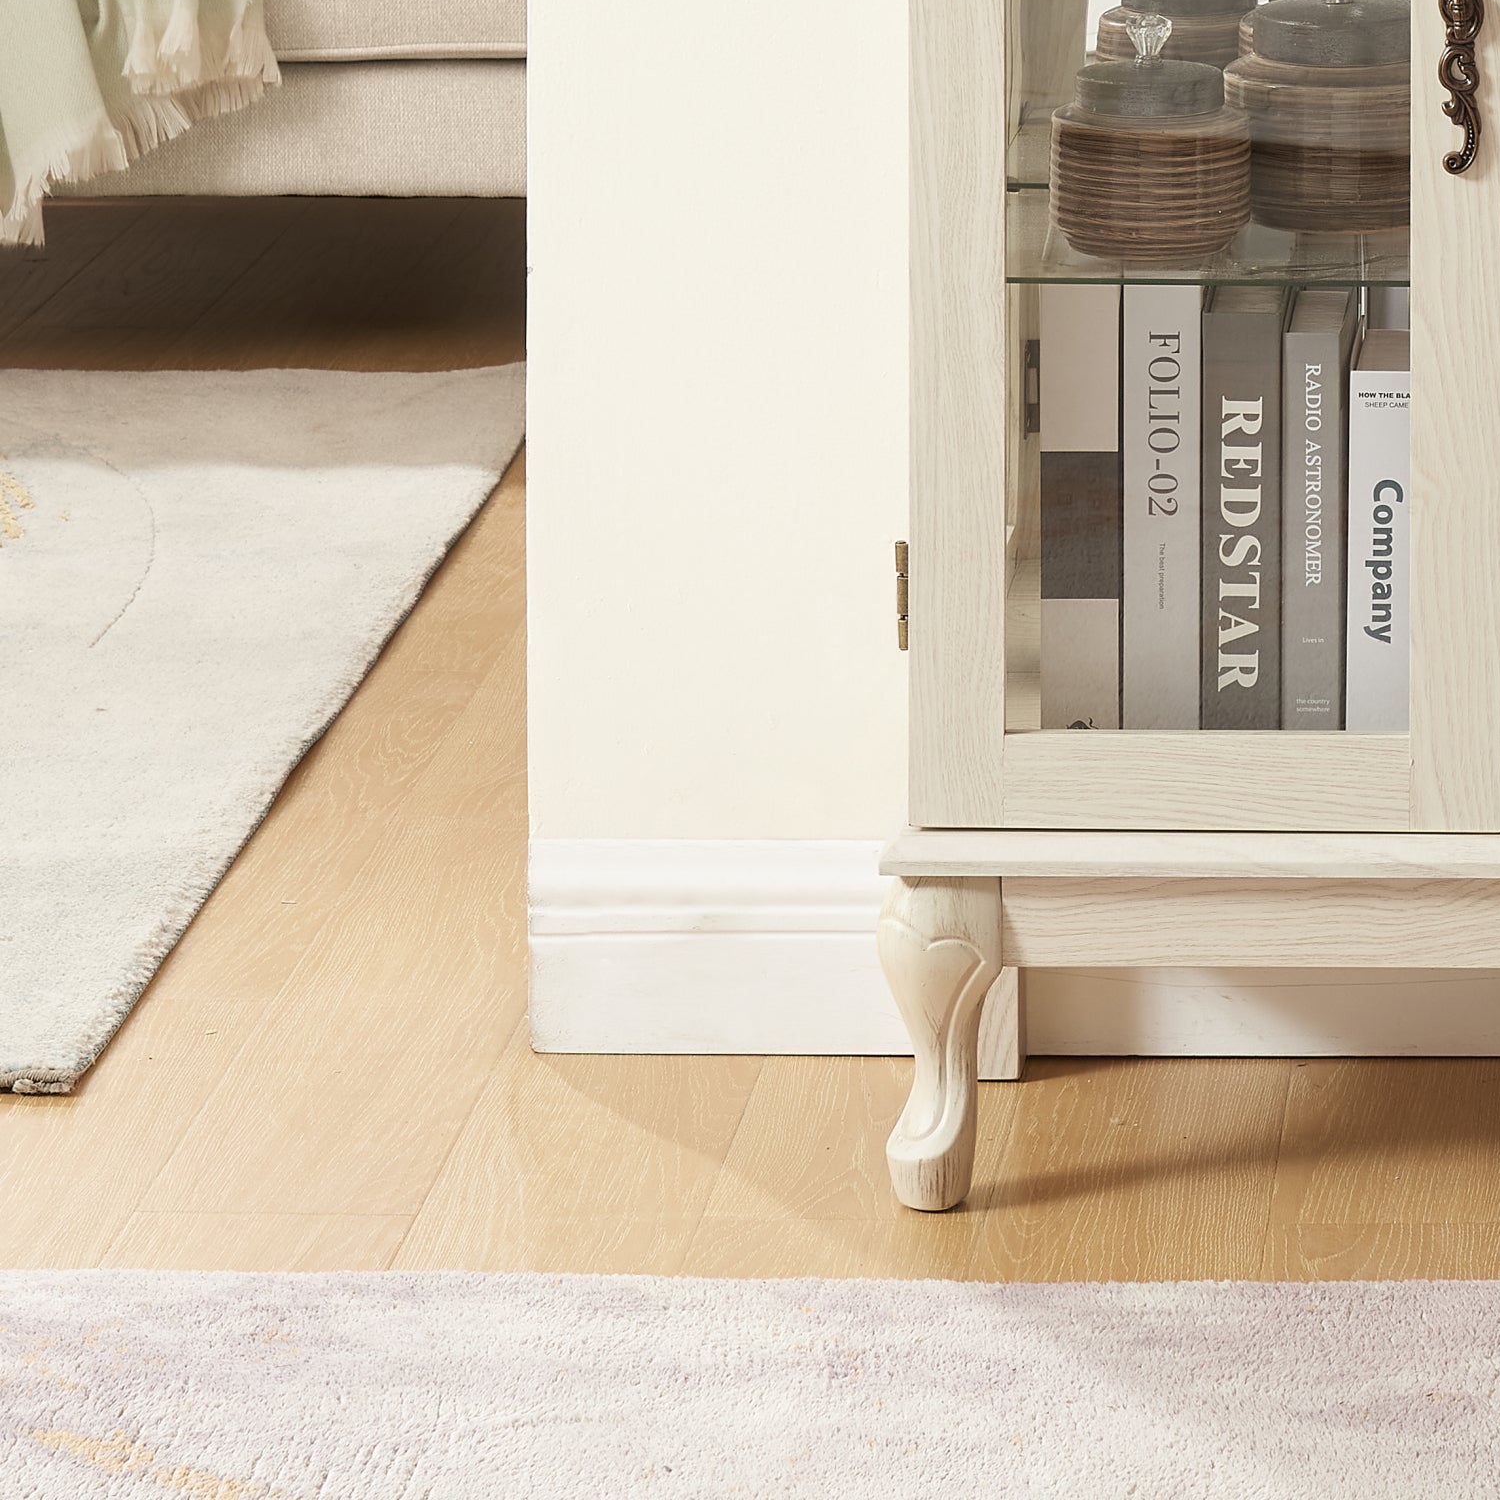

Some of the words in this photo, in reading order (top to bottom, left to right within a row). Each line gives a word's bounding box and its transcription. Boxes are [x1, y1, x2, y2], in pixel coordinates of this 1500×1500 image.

[1148, 331, 1181, 517] FOLIO-02
[1305, 363, 1322, 431] RADIO
[1217, 395, 1263, 692] REDSTAR
[1305, 438, 1322, 587] ASTRONOMER
[1363, 479, 1404, 644] Company
